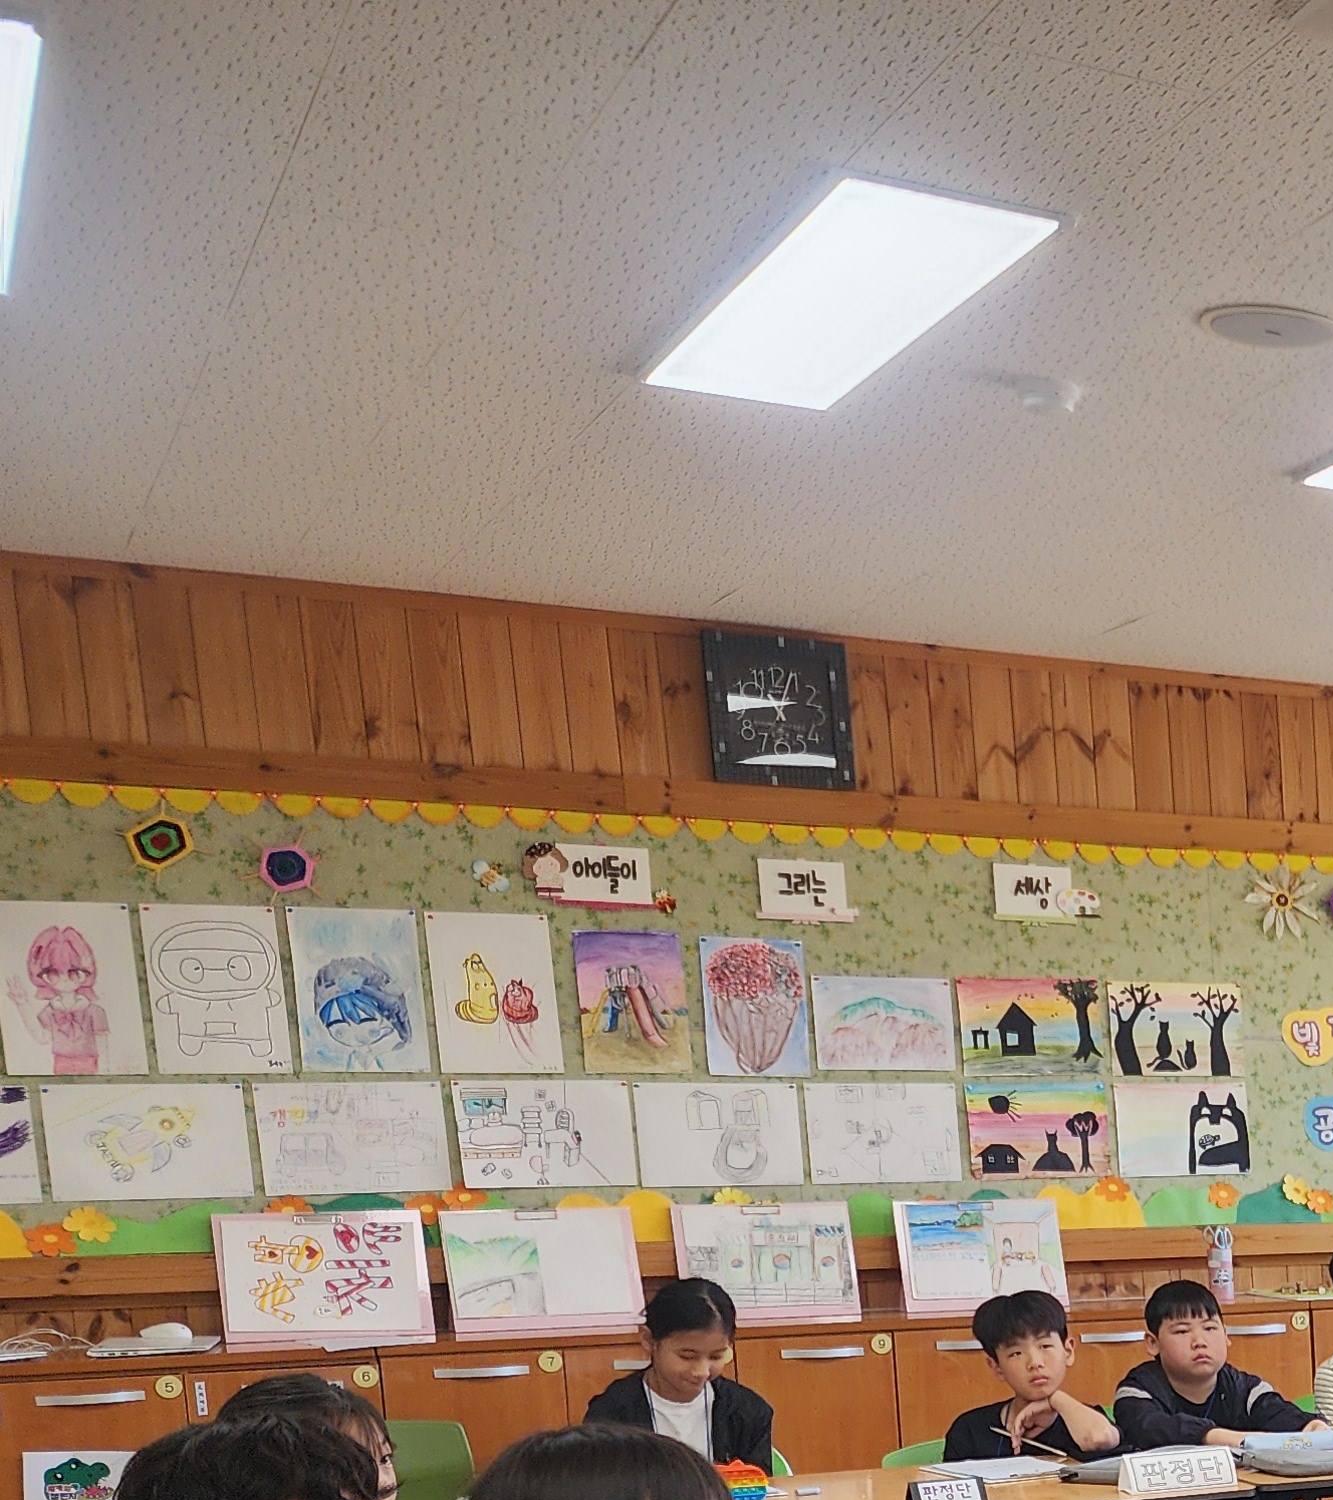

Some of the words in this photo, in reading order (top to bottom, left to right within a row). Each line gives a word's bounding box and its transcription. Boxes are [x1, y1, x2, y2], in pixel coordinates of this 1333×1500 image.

[741, 719, 755, 741] 8
[758, 732, 768, 753] 7
[572, 855, 637, 894] 아이들이
[778, 870, 827, 907] 그리는
[1013, 875, 1052, 910] 세상
[1295, 1315, 1306, 1325] 12
[878, 1339, 886, 1350] 9
[546, 1356, 555, 1367] 7
[361, 1371, 371, 1382] 6
[164, 1382, 175, 1393] 5
[1142, 1455, 1224, 1490] 판정단
